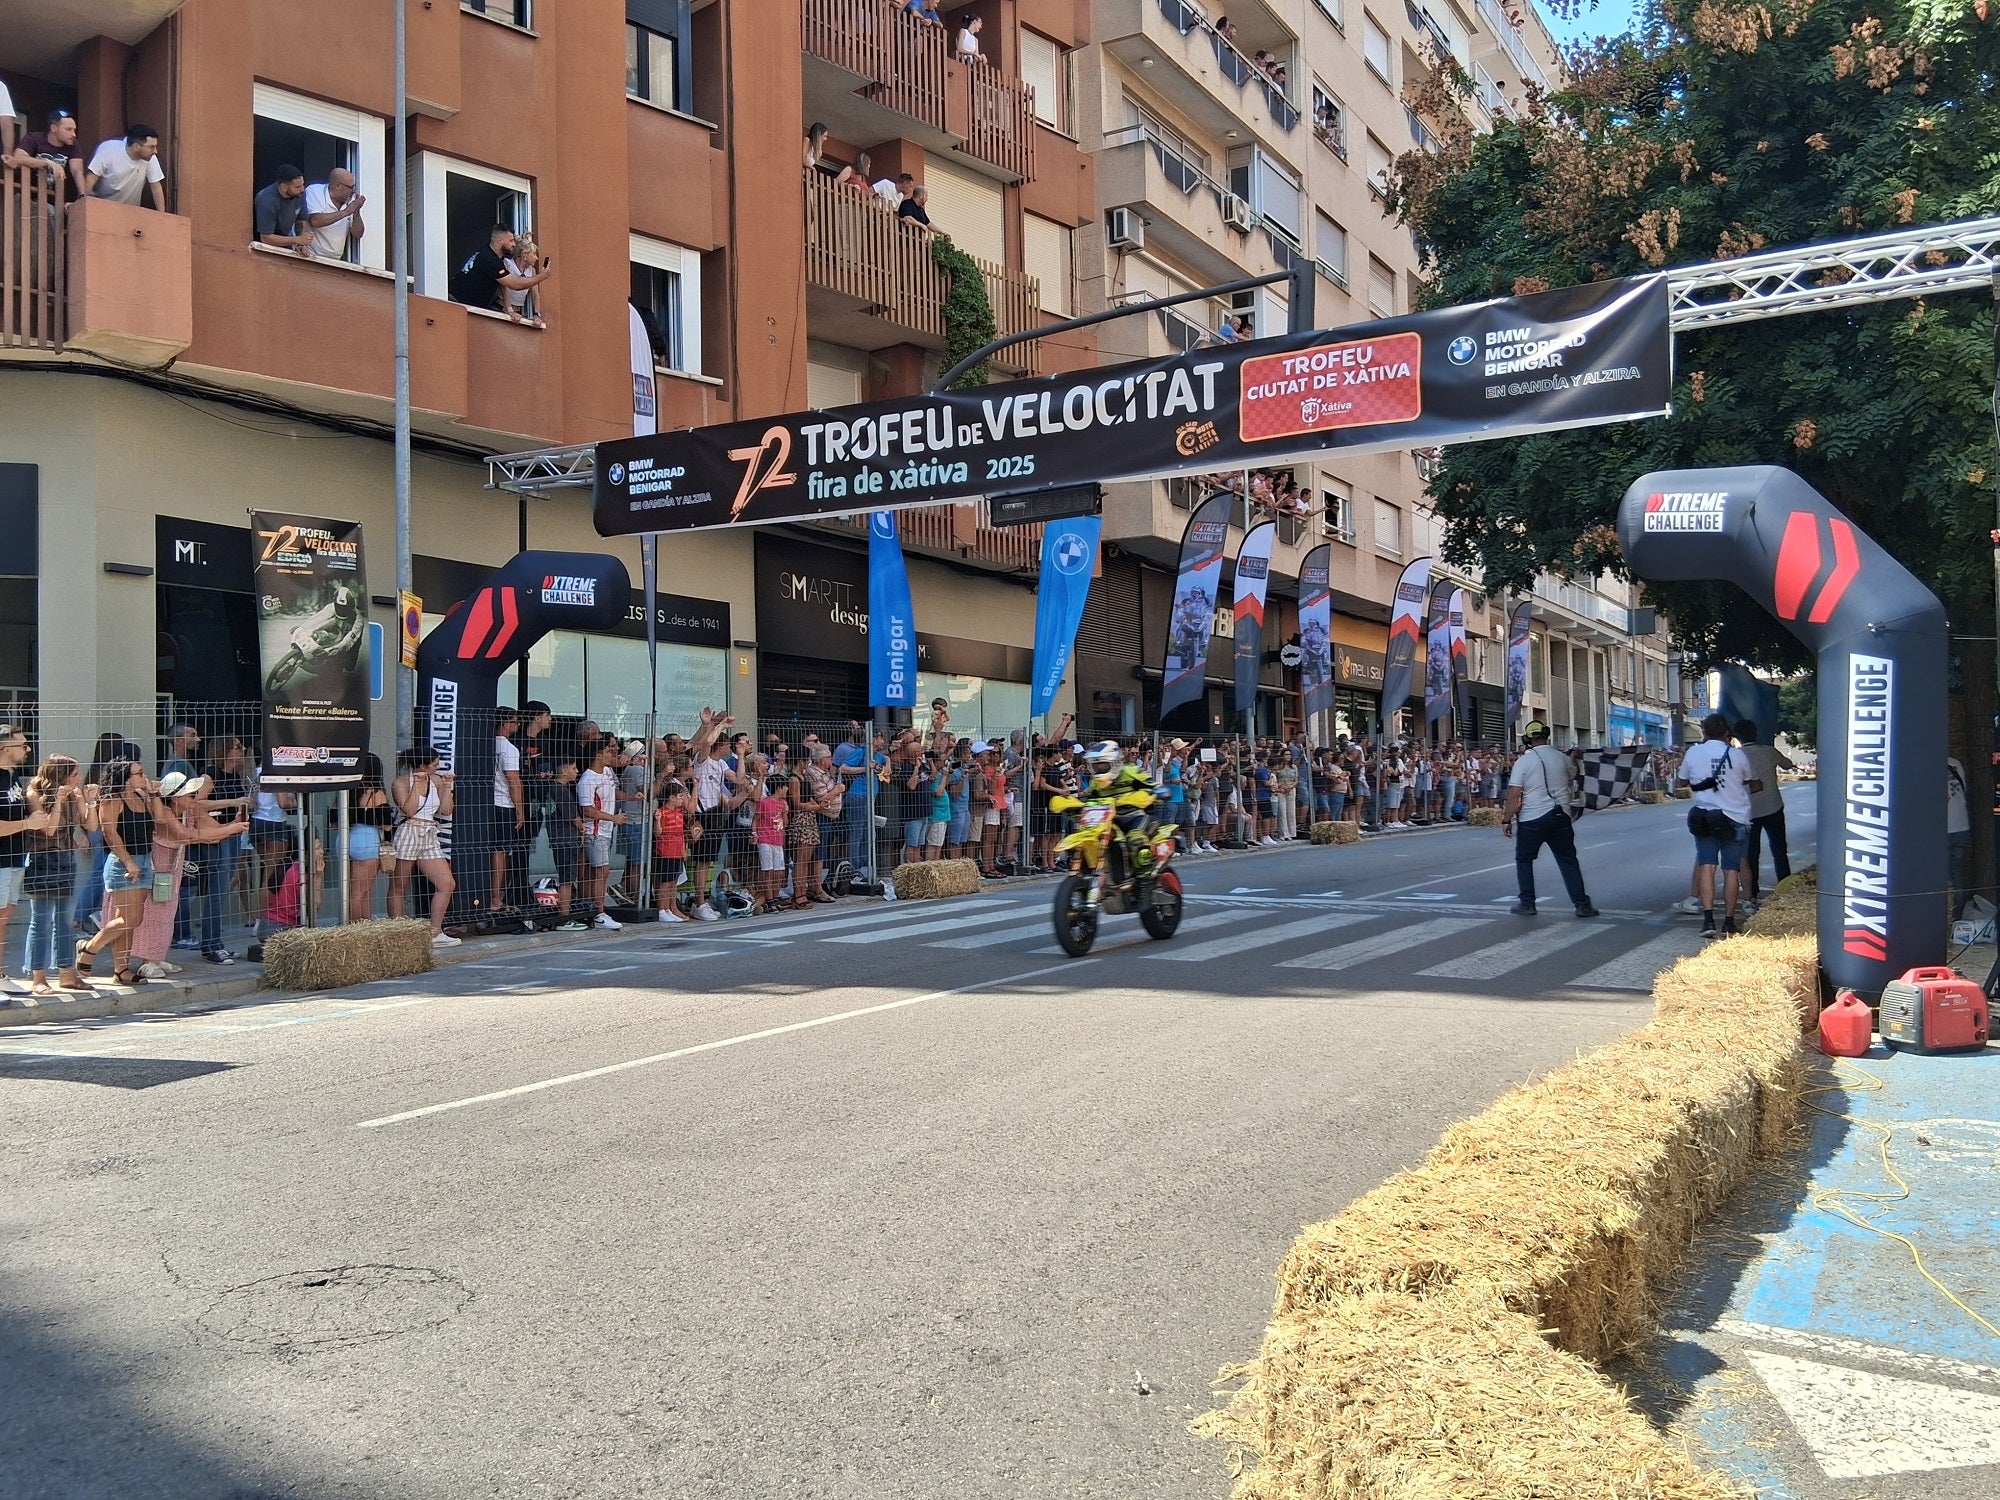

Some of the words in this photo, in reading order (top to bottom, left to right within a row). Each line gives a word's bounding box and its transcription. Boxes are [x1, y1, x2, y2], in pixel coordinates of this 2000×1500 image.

[1485, 334, 1586, 361] MOTORD
[1486, 328, 1531, 345] BMW
[1283, 346, 1372, 375] TROFEU
[1485, 354, 1563, 376] BENIGAR
[1247, 378, 1308, 400] CIUTAT
[1314, 373, 1337, 390] DE
[1344, 362, 1410, 385] XÀTIVA
[1486, 386, 1506, 399] EN
[1508, 374, 1568, 396] GANDÍA
[1570, 375, 1582, 386] Y
[1583, 367, 1640, 385] ALZIRA
[727, 426, 797, 523] 72
[800, 405, 952, 466] TROFEU
[958, 422, 984, 446] DE
[982, 362, 1224, 440] VELOCITAT
[629, 458, 654, 471] BMW
[629, 467, 684, 482] MOTORRAD
[808, 472, 846, 500] fira
[854, 466, 882, 495] de
[889, 458, 968, 490] xàtiva
[986, 454, 1035, 480] 2025
[630, 480, 672, 494] BENIGAR
[1659, 492, 1728, 512] XTREME
[1648, 514, 1719, 530] CHALLENGE
[257, 525, 302, 564] 72
[293, 527, 331, 540] TROFEU
[304, 538, 357, 553] VELOCITAT
[552, 576, 596, 591] XTREME
[780, 572, 854, 608] SMARTT
[543, 592, 592, 604] CHALLENGE
[688, 616, 699, 628] de
[701, 618, 719, 630] 1941
[830, 602, 869, 634] desig
[886, 616, 908, 698] Benigar
[1042, 642, 1066, 697] Benigar
[275, 706, 301, 714] Vicente
[434, 684, 455, 772] CHALLENGE
[1852, 664, 1888, 797] CHALLENGE
[1844, 802, 1889, 936] XTREME
